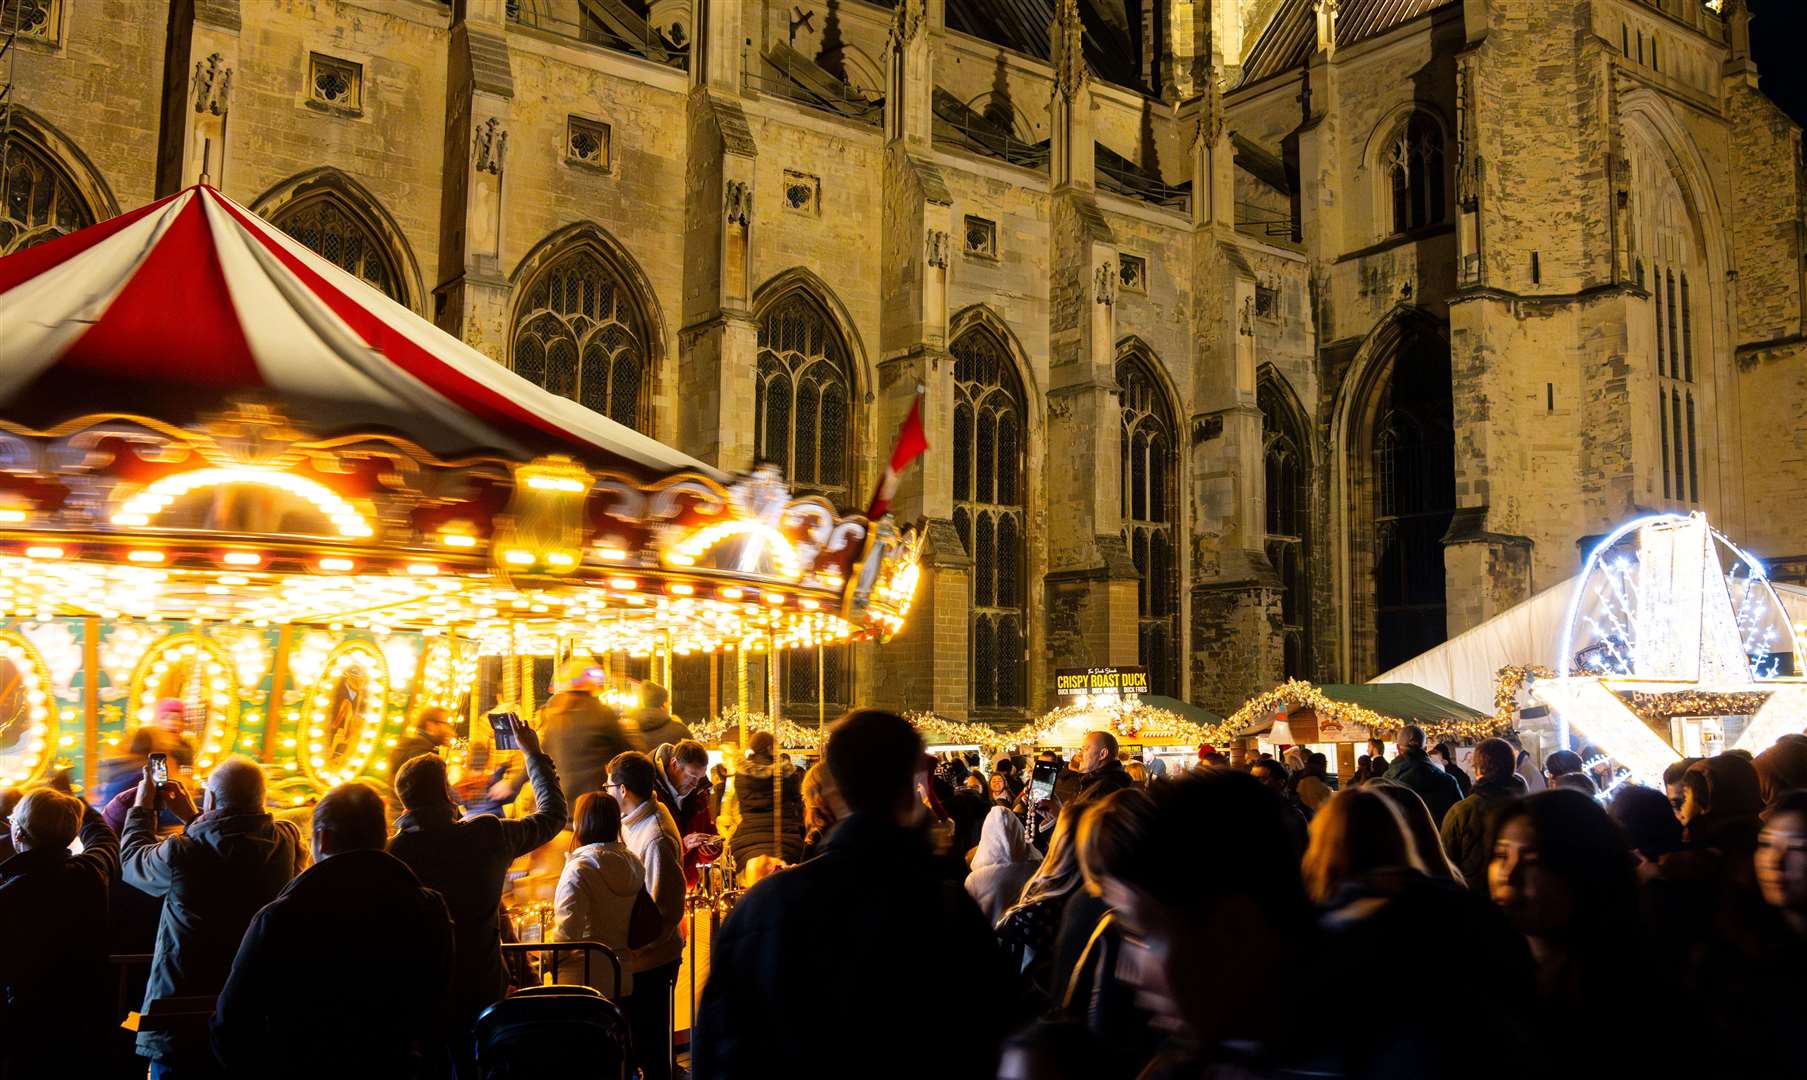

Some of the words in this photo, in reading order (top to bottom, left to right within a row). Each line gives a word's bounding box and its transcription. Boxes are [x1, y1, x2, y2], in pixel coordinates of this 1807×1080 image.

[1057, 675, 1089, 689] CRISPY
[1091, 673, 1119, 687] ROAST
[1122, 672, 1147, 687] DUCK
